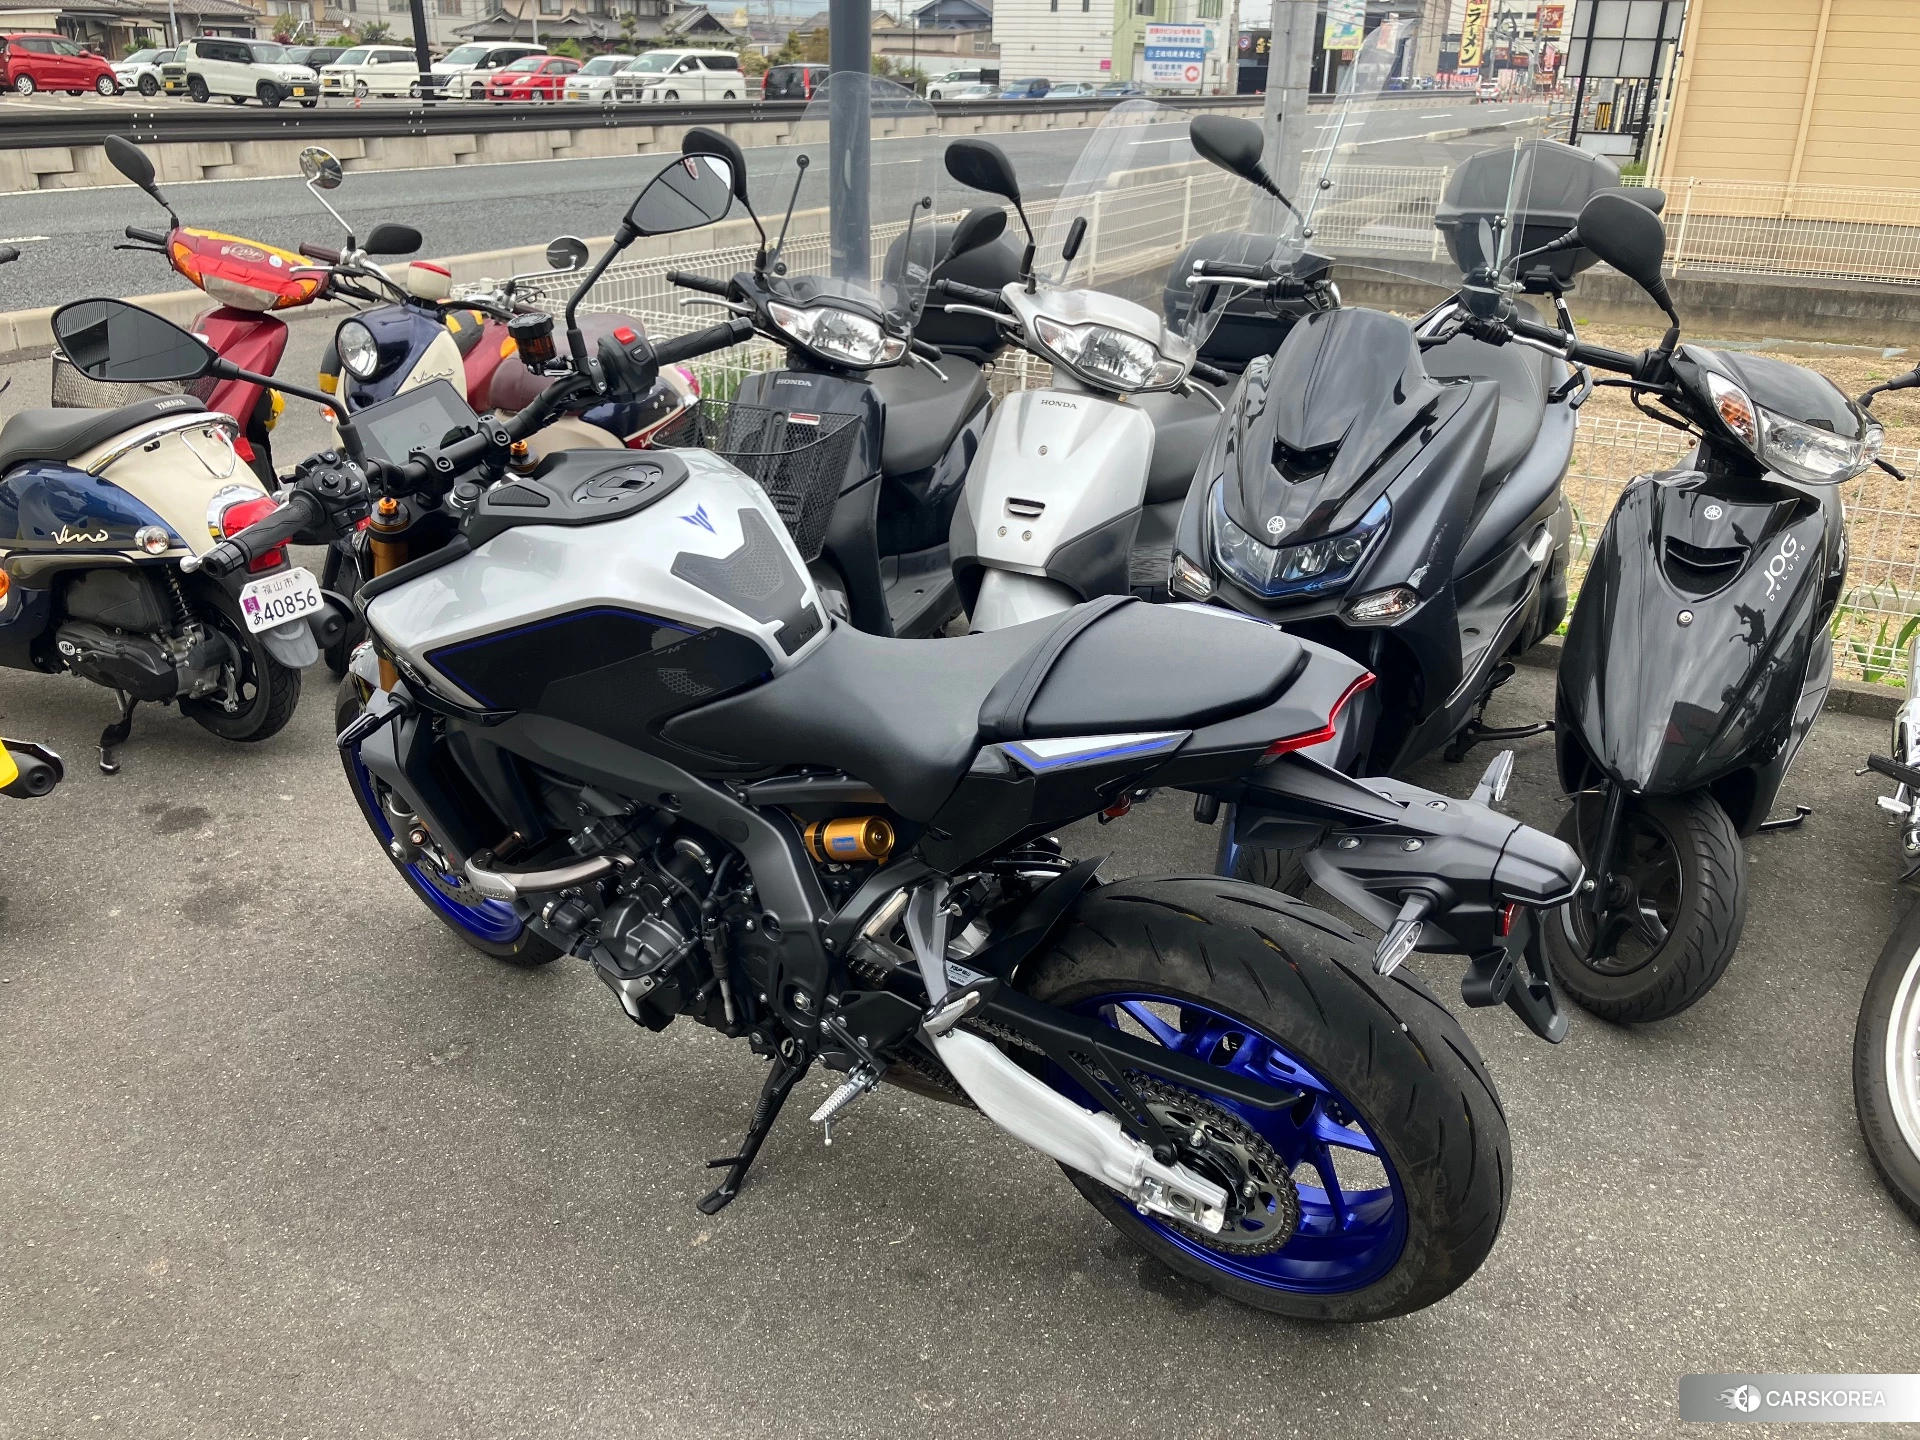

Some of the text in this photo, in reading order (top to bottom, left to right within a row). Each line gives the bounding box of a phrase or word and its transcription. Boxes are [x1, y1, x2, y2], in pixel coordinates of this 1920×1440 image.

[1461, 7, 1481, 64] ラーメン
[413, 368, 455, 383] Vino
[776, 378, 812, 388] HONDA
[154, 398, 187, 411] YAMAHA
[1041, 399, 1078, 409] HONDA
[51, 525, 108, 544] Vino
[1763, 533, 1797, 596] JOG
[262, 578, 293, 595] 福山市
[253, 612, 264, 625] あ
[264, 587, 317, 621] 40856
